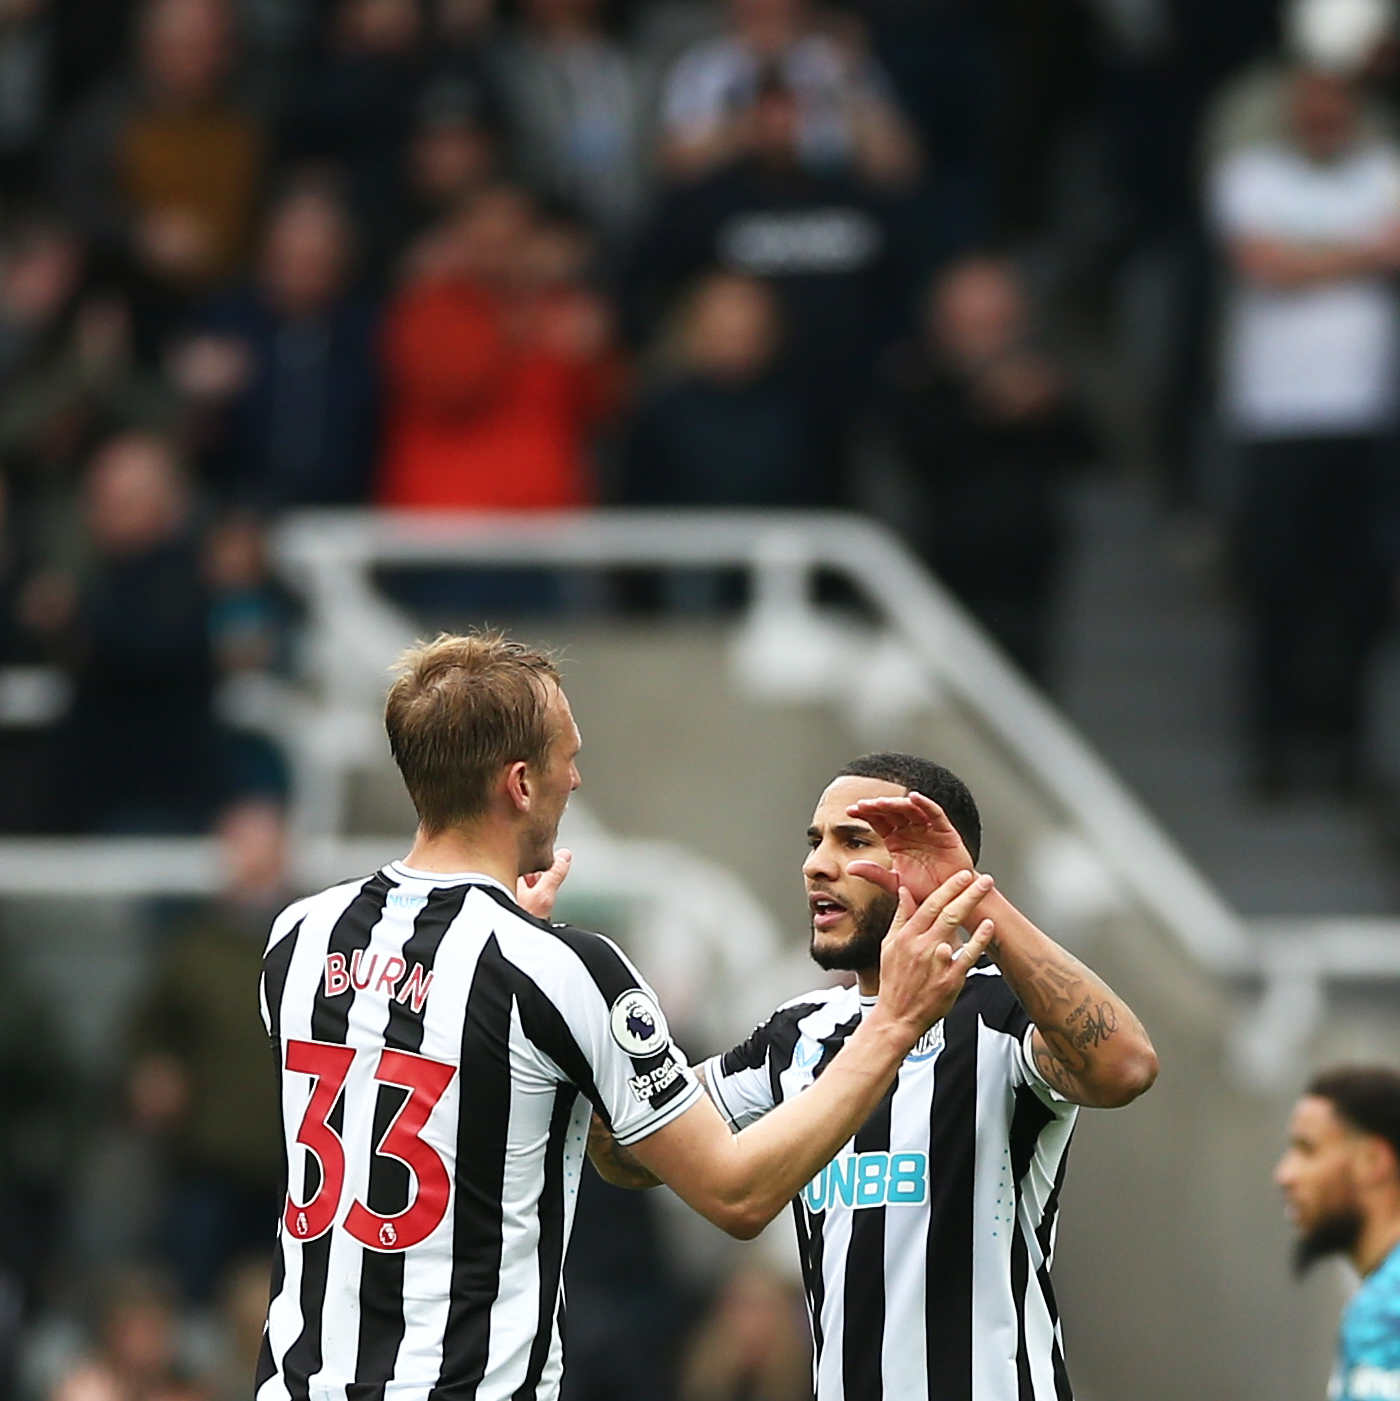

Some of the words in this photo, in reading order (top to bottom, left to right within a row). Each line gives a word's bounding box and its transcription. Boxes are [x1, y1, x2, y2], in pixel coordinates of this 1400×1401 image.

[324, 949, 435, 1014] BURN
[627, 1074, 651, 1095] No
[283, 1038, 458, 1253] 33
[798, 1150, 929, 1215] UN88
